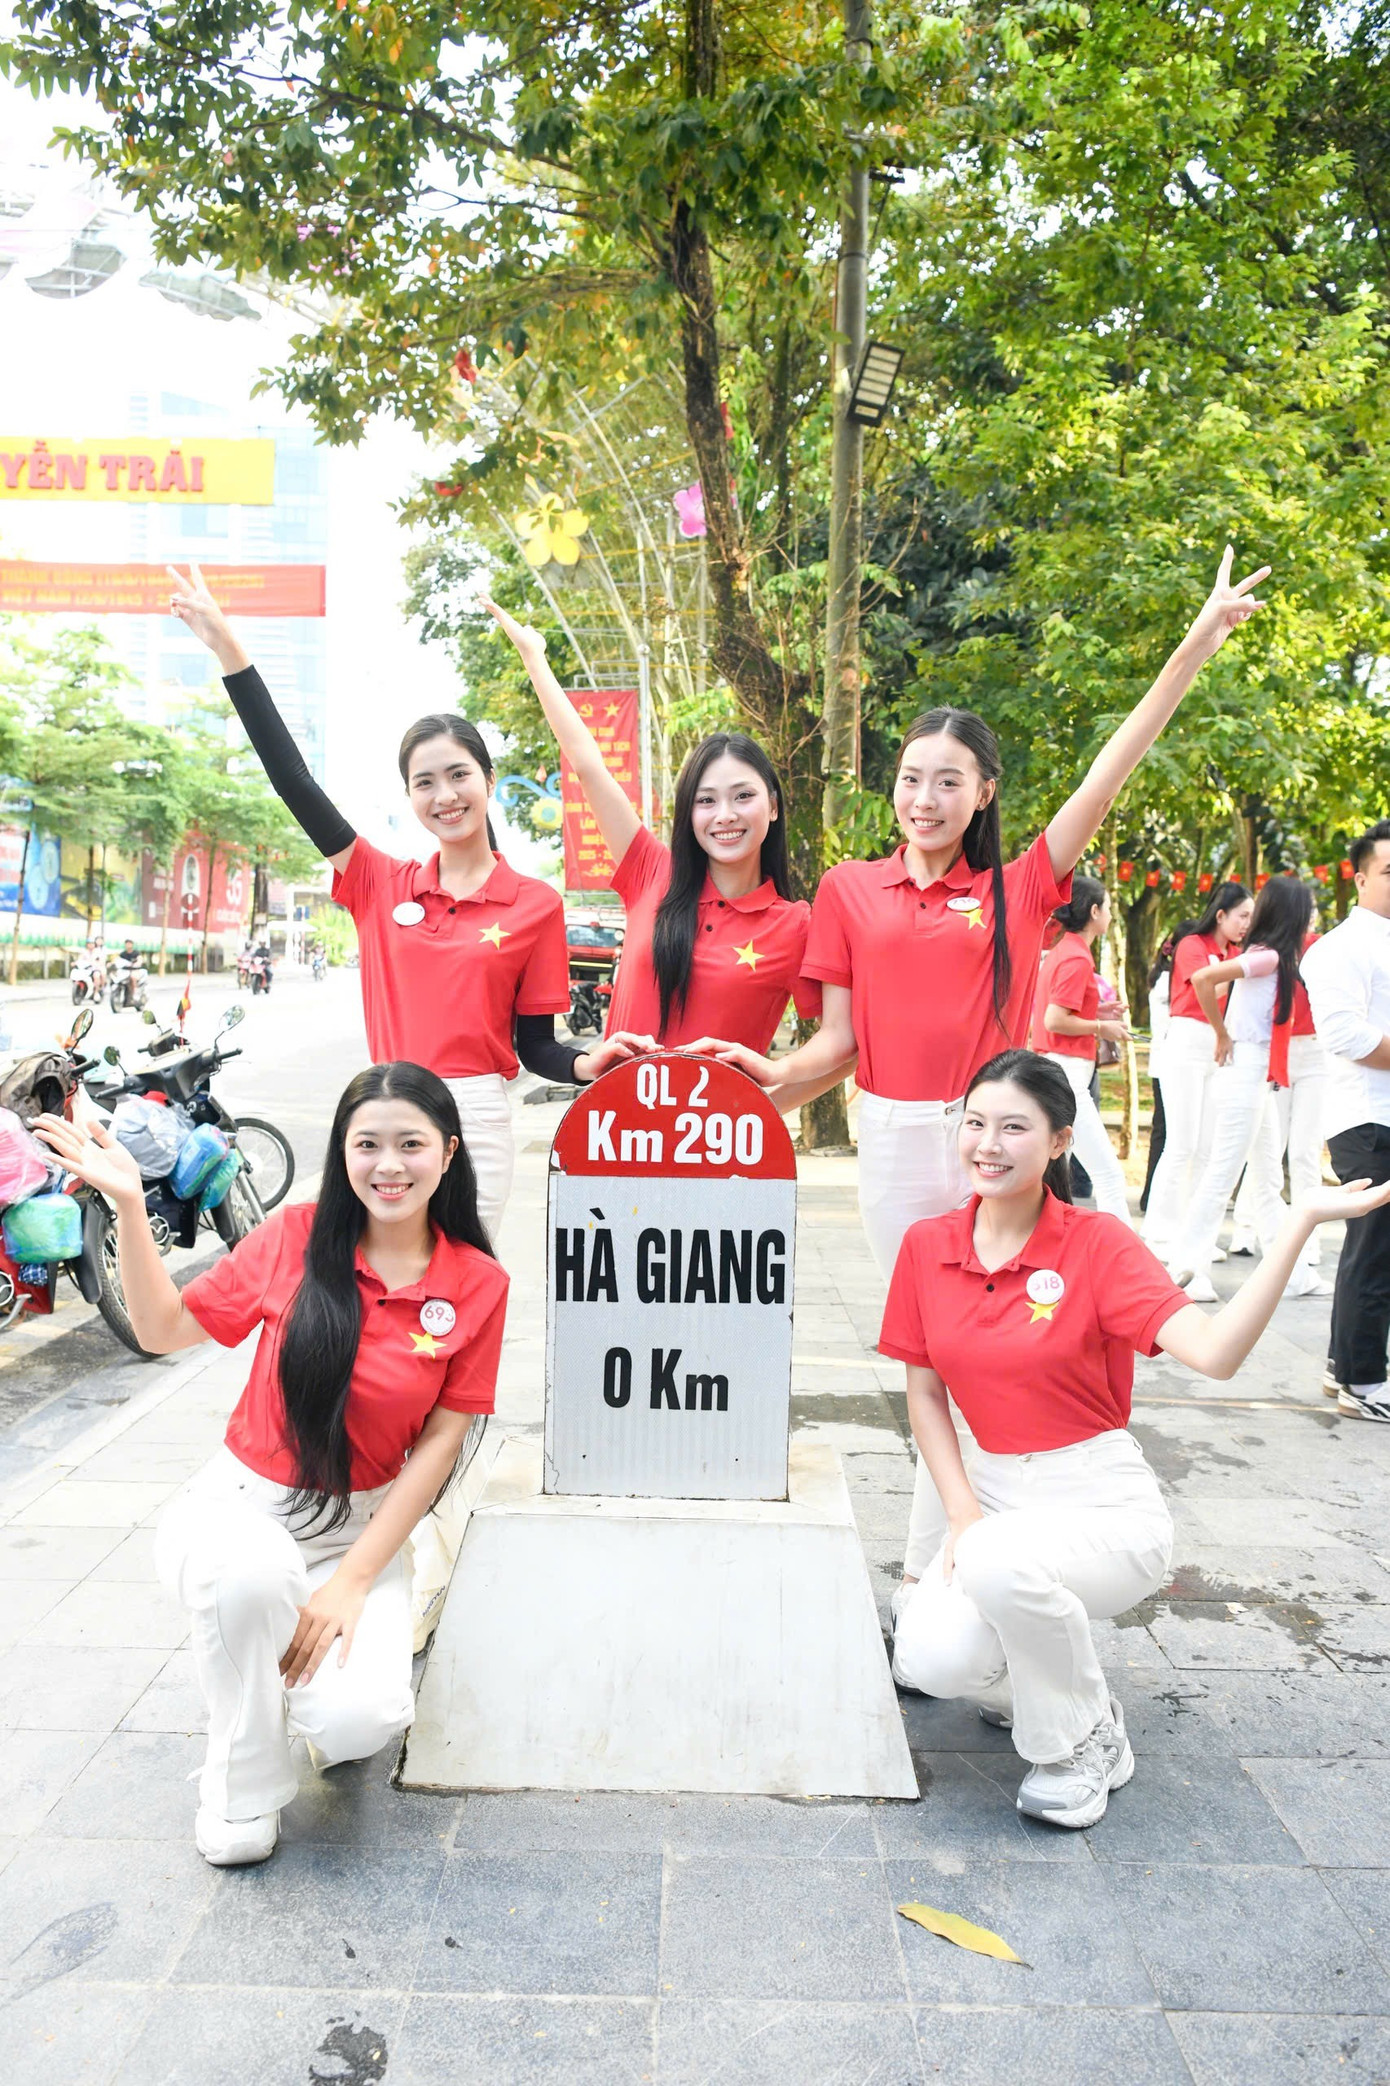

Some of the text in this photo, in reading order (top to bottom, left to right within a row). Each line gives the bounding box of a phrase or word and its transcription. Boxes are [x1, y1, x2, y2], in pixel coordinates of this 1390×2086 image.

[637, 1063, 709, 1110] QL 2
[588, 1110, 764, 1165] Km 290
[556, 1207, 786, 1305] HÀ GIANG
[603, 1346, 729, 1411] 0 Km
